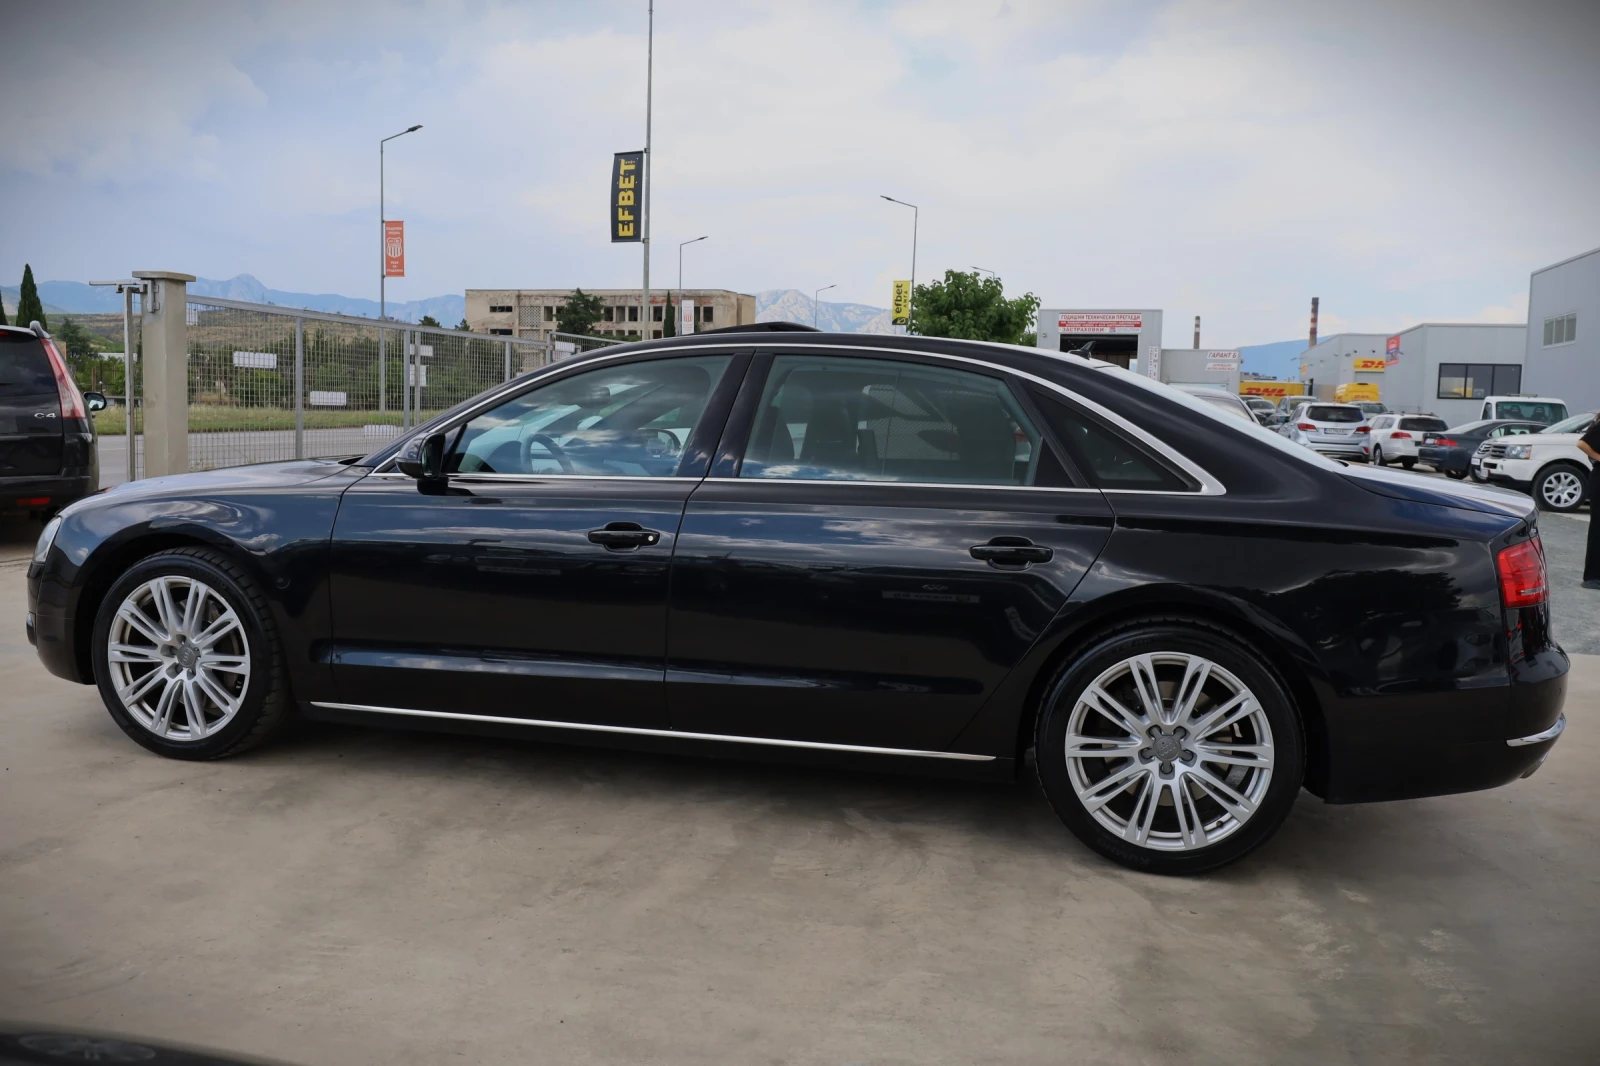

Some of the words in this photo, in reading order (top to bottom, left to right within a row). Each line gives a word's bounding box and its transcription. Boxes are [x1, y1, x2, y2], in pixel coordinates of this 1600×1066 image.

[618, 159, 635, 236] EFBET
[895, 284, 903, 313] efbet
[1361, 360, 1385, 368] DH
[1246, 387, 1285, 396] DHL
